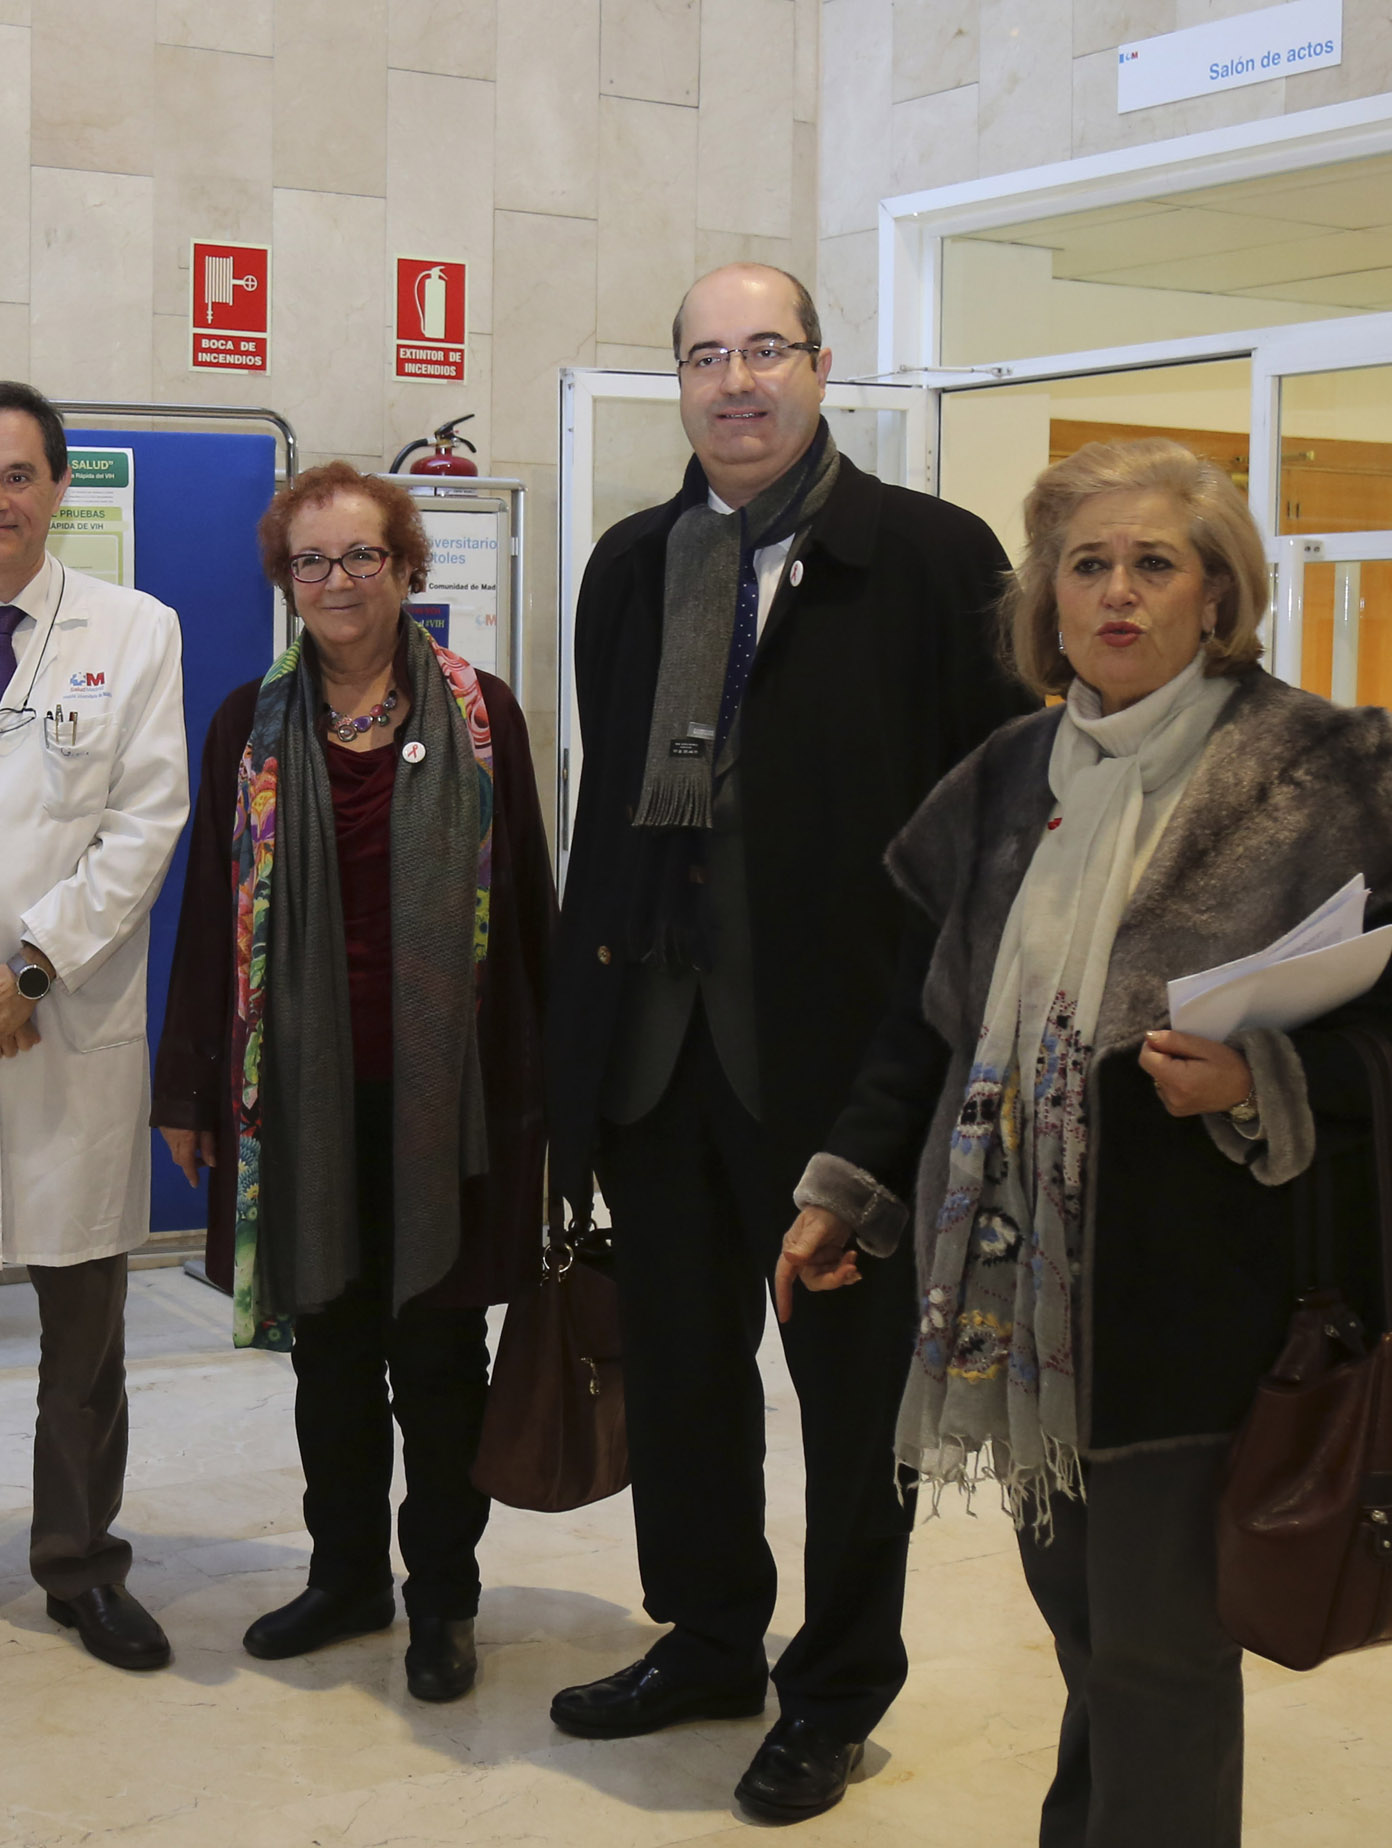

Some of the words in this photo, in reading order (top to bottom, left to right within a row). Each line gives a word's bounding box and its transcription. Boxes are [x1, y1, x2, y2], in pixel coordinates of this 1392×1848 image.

[1209, 56, 1255, 80] Salón
[1261, 51, 1281, 68] de
[1287, 40, 1334, 61] actos
[202, 338, 234, 350] BOCA
[241, 341, 256, 352] DE
[198, 352, 262, 366] INCENDIOS
[400, 348, 444, 362] EXTINTOR
[449, 351, 462, 362] DE
[404, 363, 456, 376] INCENDIOS
[60, 510, 105, 518] PRUEBAS
[49, 521, 75, 529] ÁPIDA
[77, 522, 88, 530] DE
[90, 522, 104, 530] VIH
[431, 536, 498, 550] iversitario
[429, 582, 468, 590] Comunidad
[481, 583, 496, 591] Mad
